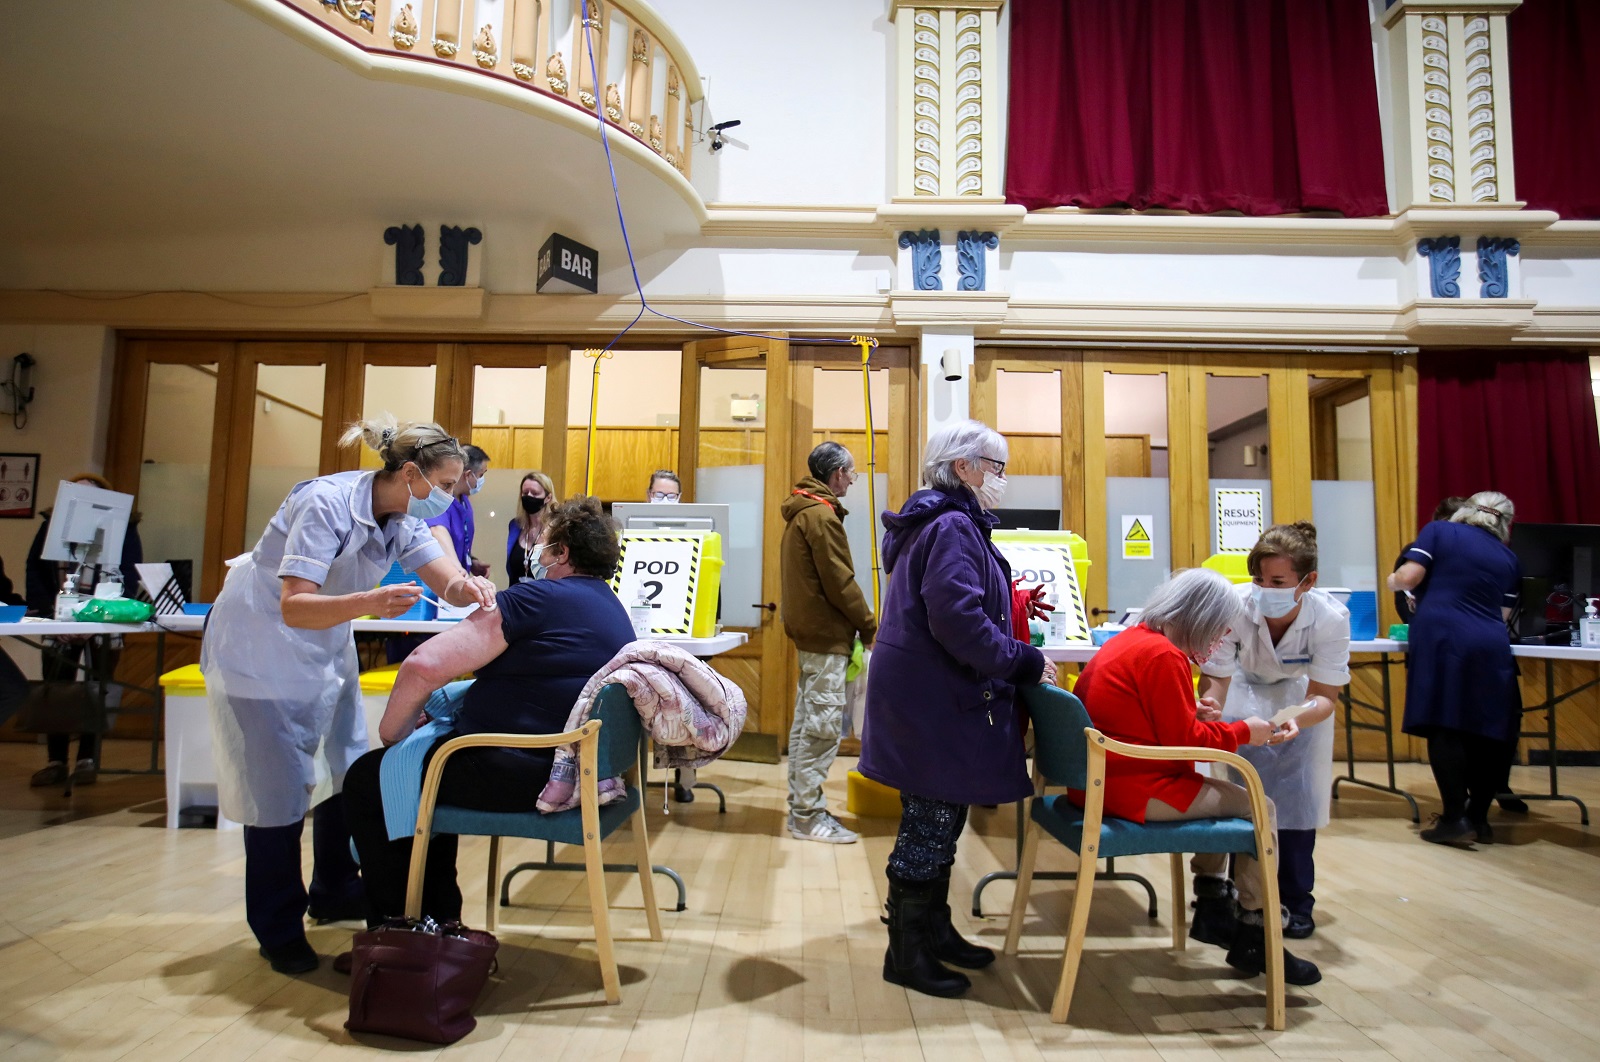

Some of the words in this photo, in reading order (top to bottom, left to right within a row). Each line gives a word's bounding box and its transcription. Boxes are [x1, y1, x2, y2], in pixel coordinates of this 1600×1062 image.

[561, 248, 592, 280] BAR
[1223, 508, 1256, 518] RESUS
[633, 560, 680, 575] POD
[642, 580, 664, 609] 2
